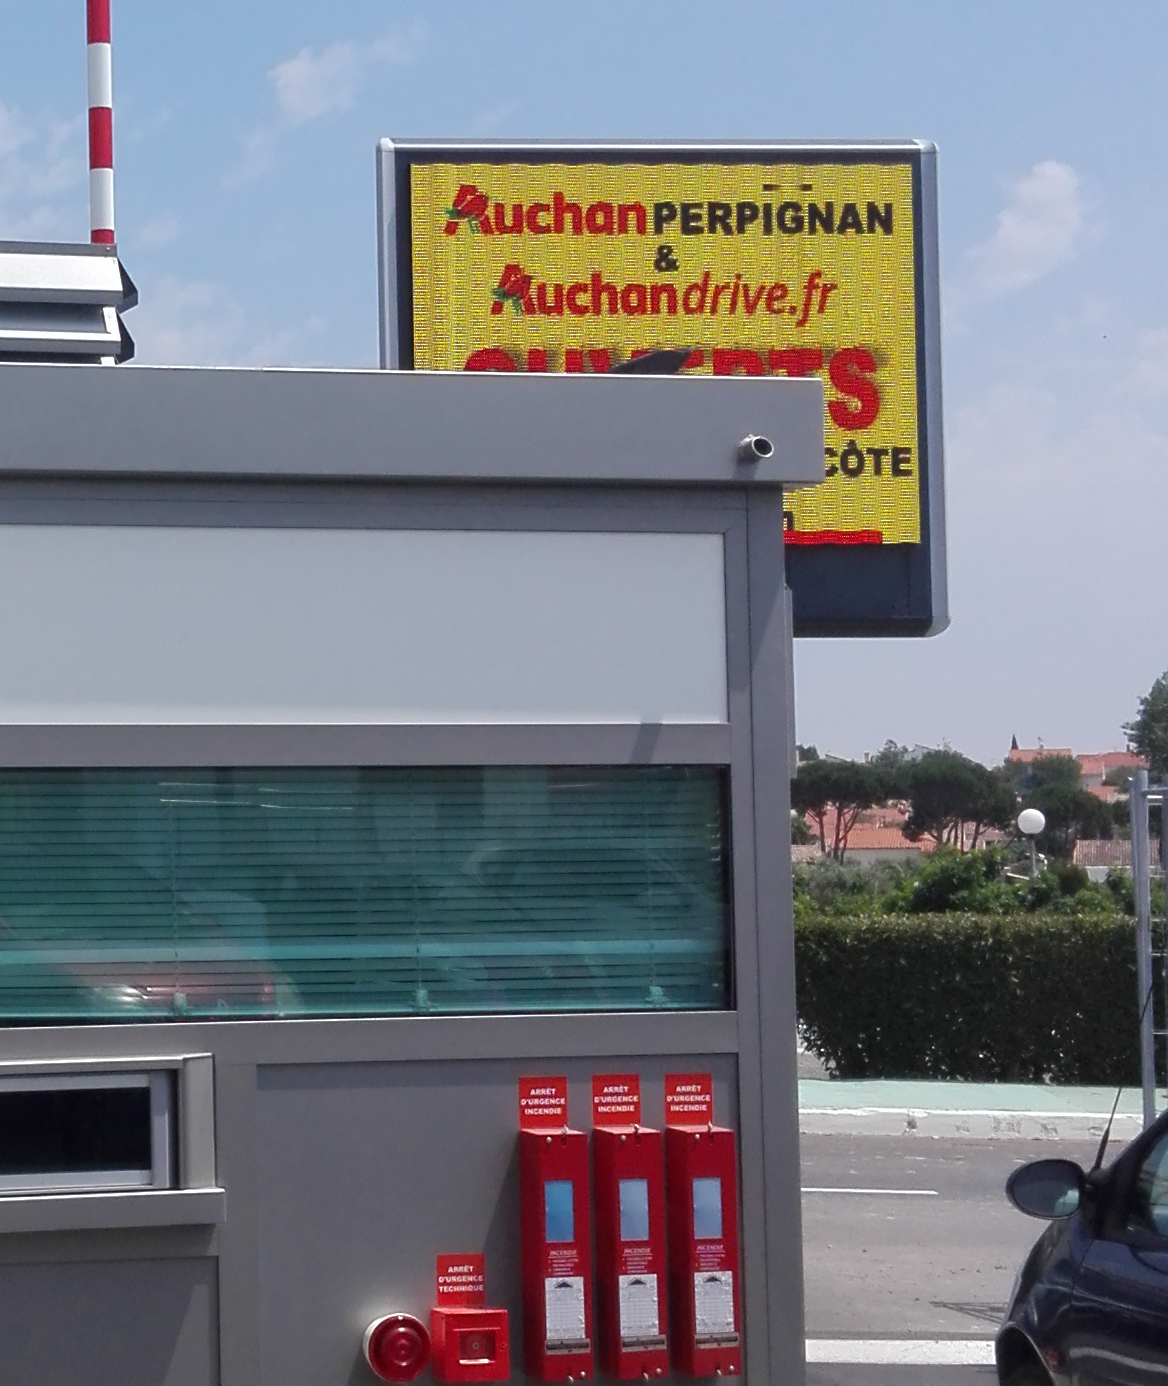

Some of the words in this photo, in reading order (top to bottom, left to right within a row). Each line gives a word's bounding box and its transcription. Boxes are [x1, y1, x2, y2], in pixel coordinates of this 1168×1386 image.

[444, 185, 646, 236] Auchan
[654, 201, 893, 236] PERPIGNAN
[654, 245, 680, 273] &
[520, 1097, 566, 1105] D'URGENCE
[593, 1095, 639, 1103] D'URGENCE
[666, 1094, 711, 1102] D'URGENCE
[525, 1107, 563, 1115] INCENDIE
[598, 1104, 635, 1112] INCENDIE
[670, 1103, 708, 1111] INCENDIE
[447, 1265, 474, 1273] ARRÊT
[438, 1275, 484, 1283] D'URGENCE
[438, 1284, 484, 1293] TECHNIQUE
